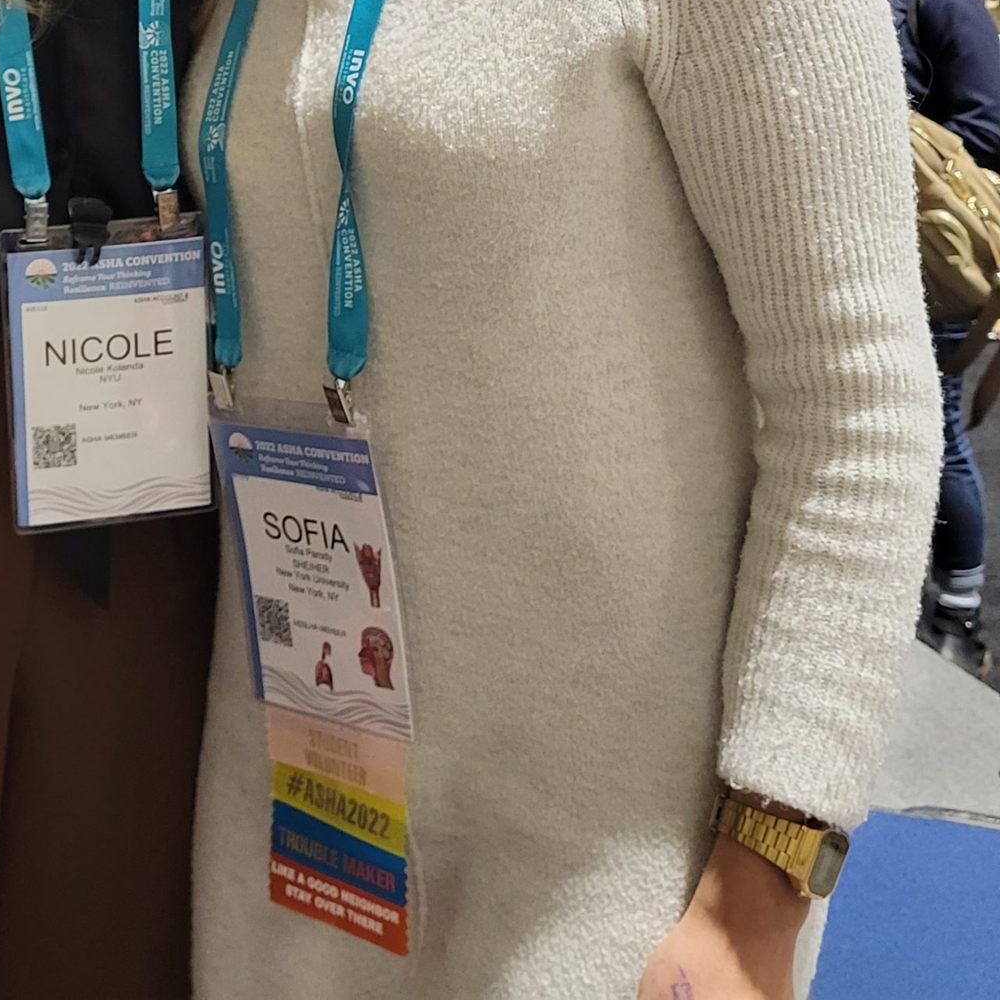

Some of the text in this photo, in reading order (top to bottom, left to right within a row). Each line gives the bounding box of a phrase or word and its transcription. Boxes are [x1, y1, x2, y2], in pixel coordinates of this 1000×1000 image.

[150, 50, 163, 125] CONVENTION
[159, 50, 170, 109] 2022 ASHA
[213, 50, 234, 122] CONVENTION
[125, 250, 201, 267] CONVENTION
[341, 228, 354, 309] CONVENTION
[348, 228, 362, 292] 2022 ASHA
[45, 329, 174, 366] NICOLE
[304, 447, 370, 465] CONVENTION
[263, 512, 350, 553] SOFIA
[287, 771, 390, 839] #ASHA2022
[278, 826, 396, 893] TROUBLE MAKER
[271, 860, 400, 925] LIKE A GOOD NEIGHBOR
[285, 883, 384, 936] STAY OVER THERE
